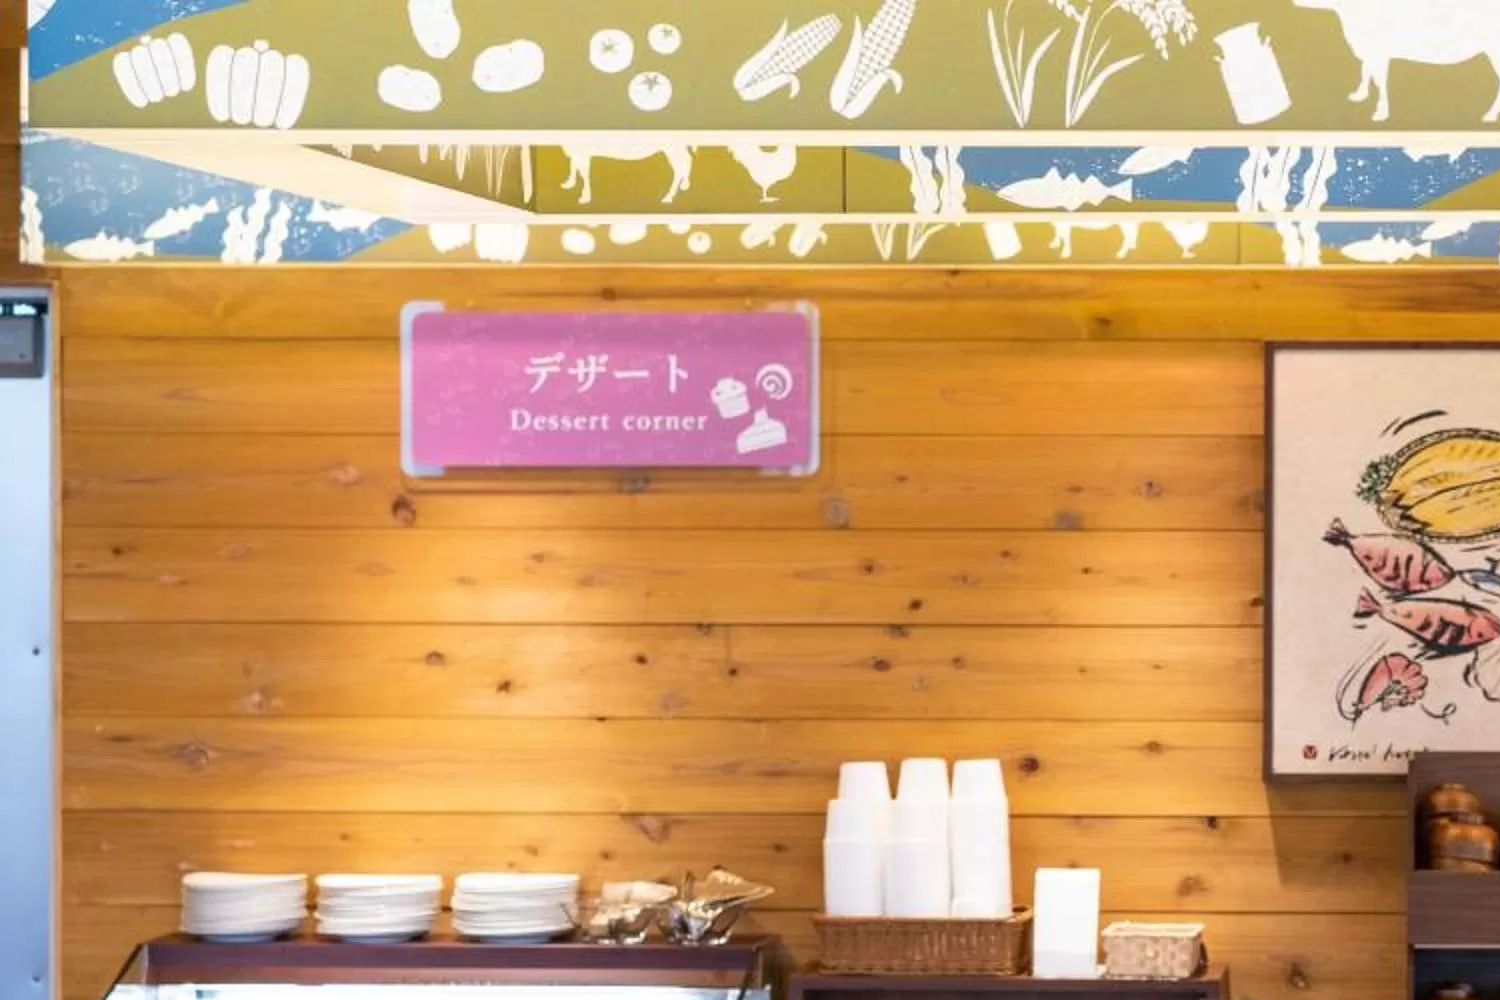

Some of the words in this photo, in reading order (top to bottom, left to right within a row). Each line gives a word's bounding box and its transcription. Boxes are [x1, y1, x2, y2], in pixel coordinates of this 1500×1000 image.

[524, 352, 689, 394] デザート
[511, 409, 609, 431] Dessert
[623, 413, 707, 431] corner
